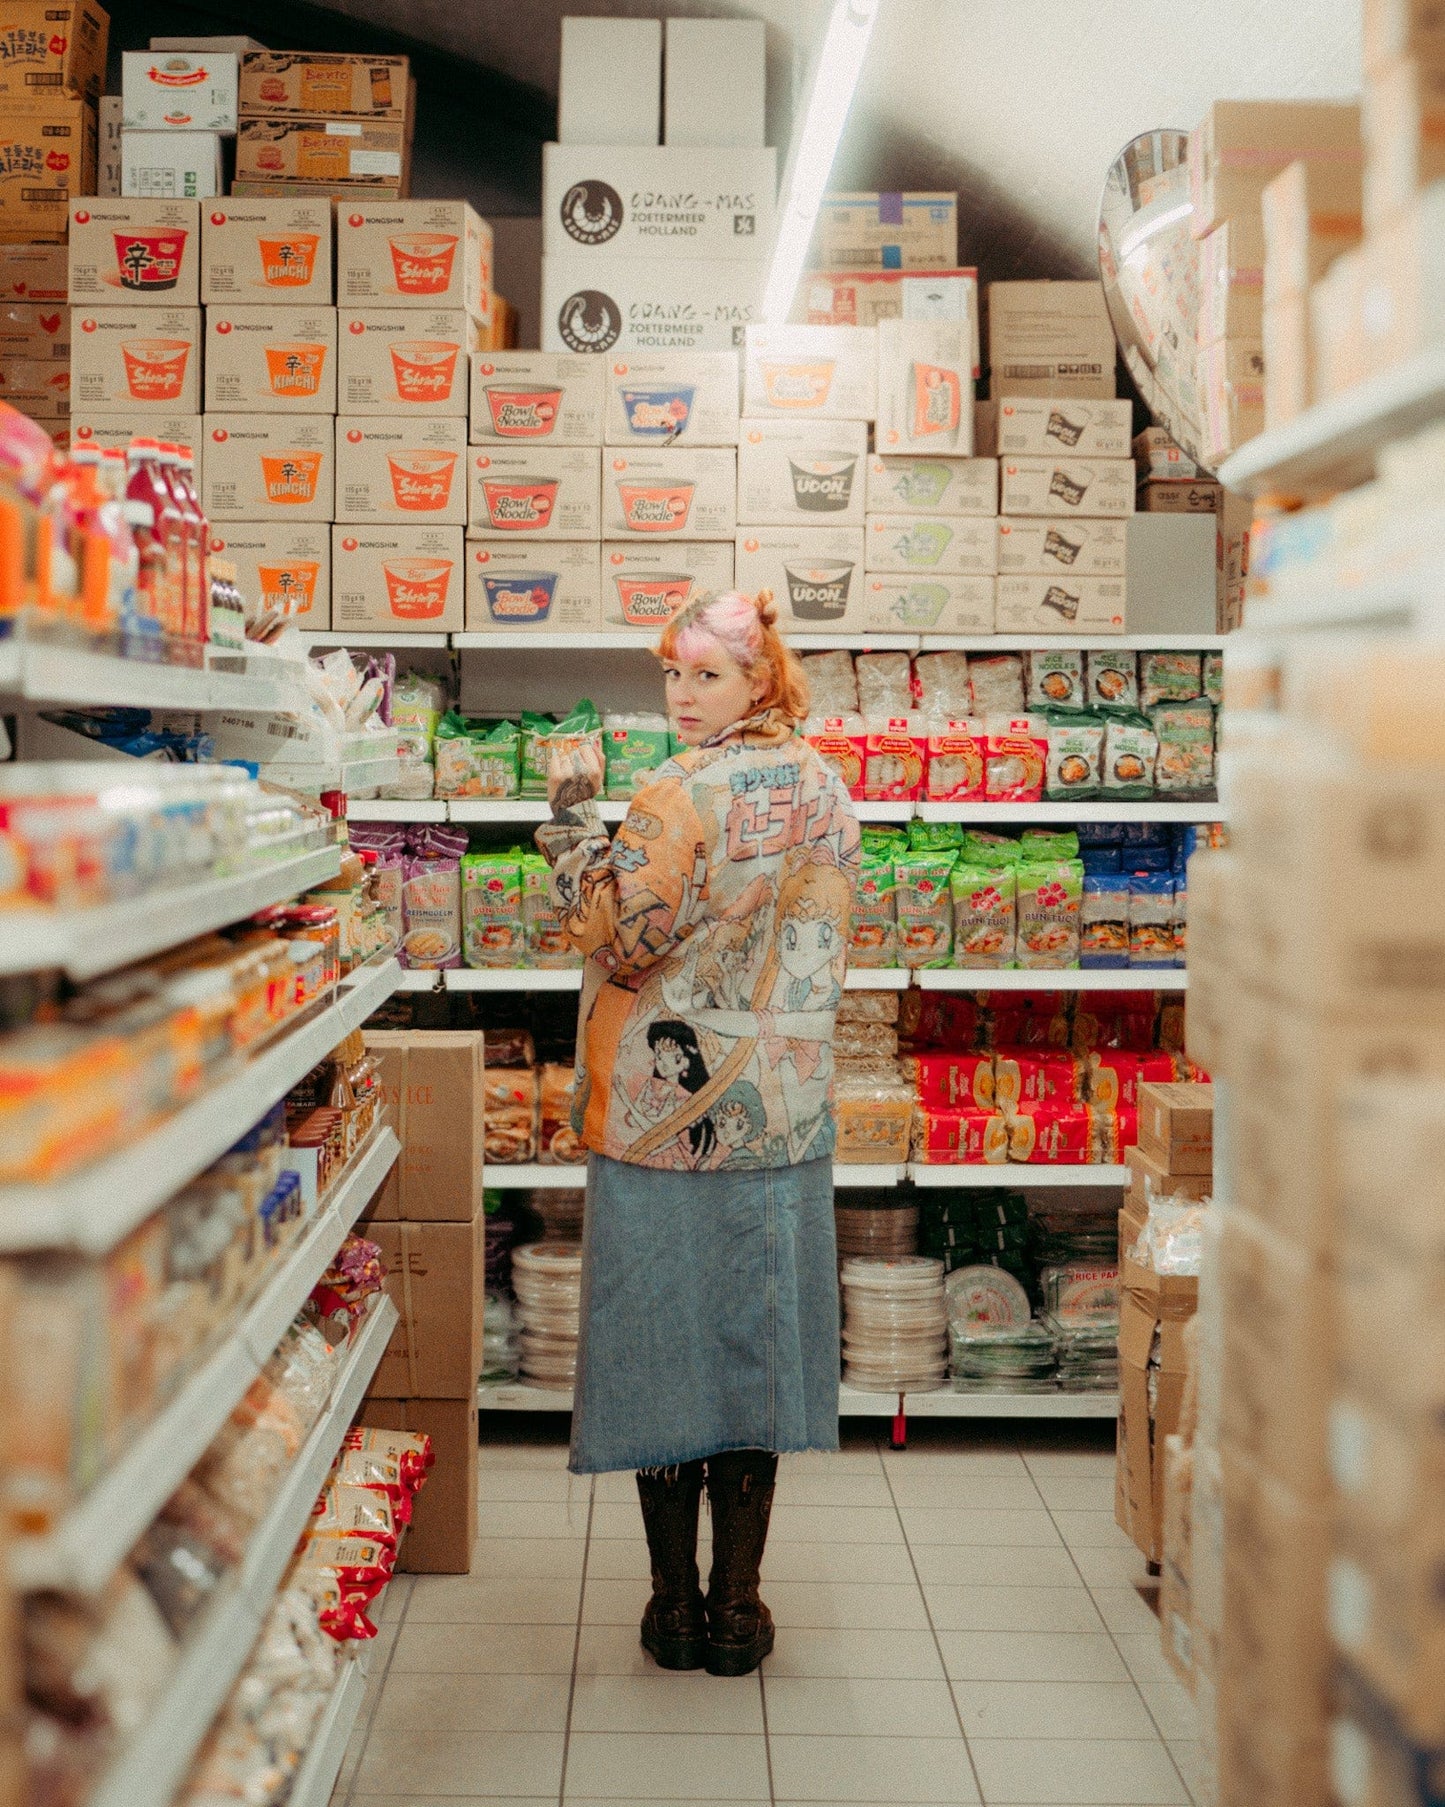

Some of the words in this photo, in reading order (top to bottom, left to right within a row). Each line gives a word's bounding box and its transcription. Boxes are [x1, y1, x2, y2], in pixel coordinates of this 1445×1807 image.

[631, 213, 706, 223] ZOETERMEER
[639, 226, 697, 236] HOLLAND
[124, 243, 153, 285] 辛
[268, 265, 309, 280] KIMCHI
[629, 323, 704, 334] ZOETERMEER
[637, 336, 696, 347] HOLLAND
[275, 374, 316, 390] KIMCHI
[502, 403, 534, 418] Bowl
[497, 415, 541, 427] Noodle
[270, 482, 311, 498] KIMCHI
[796, 479, 845, 494] UDON
[498, 496, 530, 511] Bowl
[634, 499, 666, 513] Bowl
[494, 508, 538, 520] Noodle
[630, 510, 673, 522] Noodle
[632, 592, 664, 606] Bowl
[792, 587, 842, 602] UDON
[628, 604, 671, 616] Noodle
[1074, 1271, 1097, 1281] RICE
[1101, 1270, 1119, 1280] PAP
